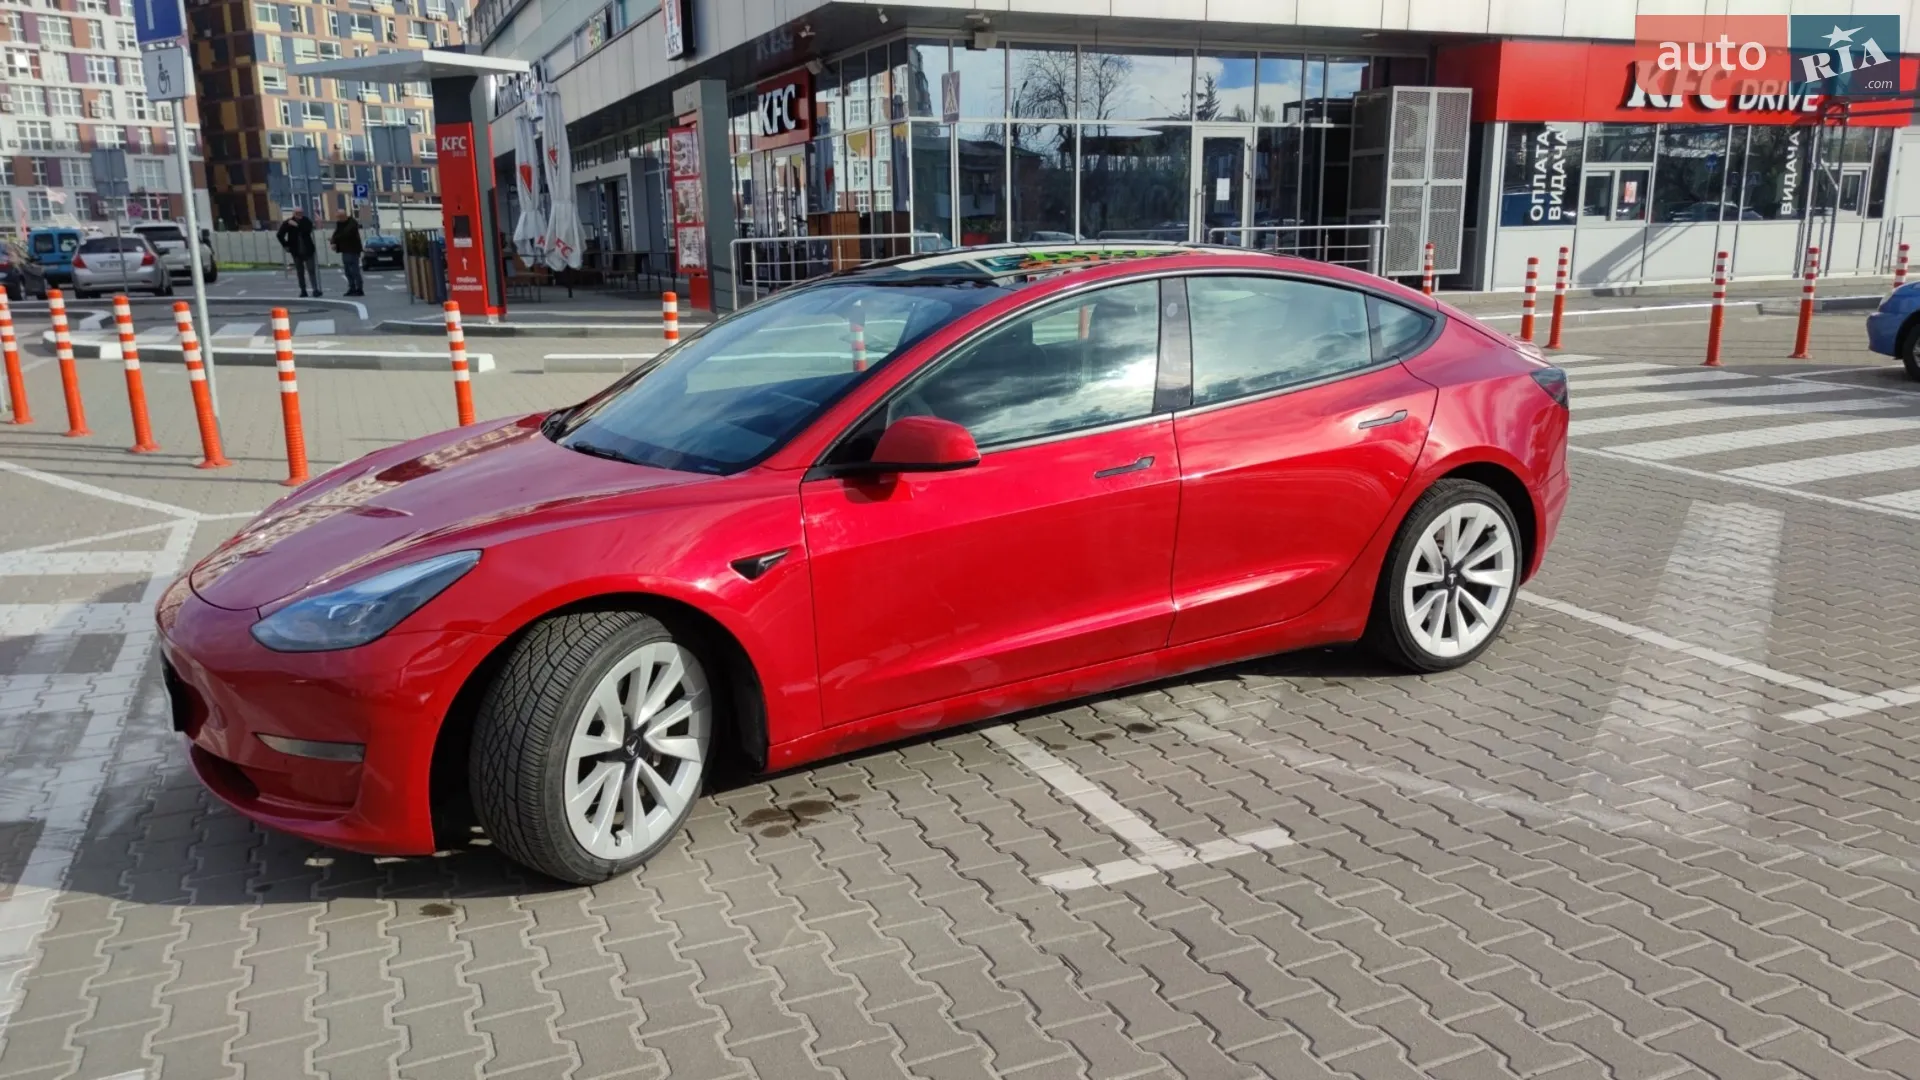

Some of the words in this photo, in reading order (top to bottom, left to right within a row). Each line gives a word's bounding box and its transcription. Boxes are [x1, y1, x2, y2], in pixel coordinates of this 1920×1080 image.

[758, 83, 796, 136] KFC
[1627, 60, 1732, 109] KFC
[1738, 79, 1824, 112] DRIVE
[441, 136, 467, 151] KFC
[356, 185, 366, 197] P
[1548, 129, 1568, 220] ВИДАЧА
[1781, 131, 1801, 215] ВИДАЧА
